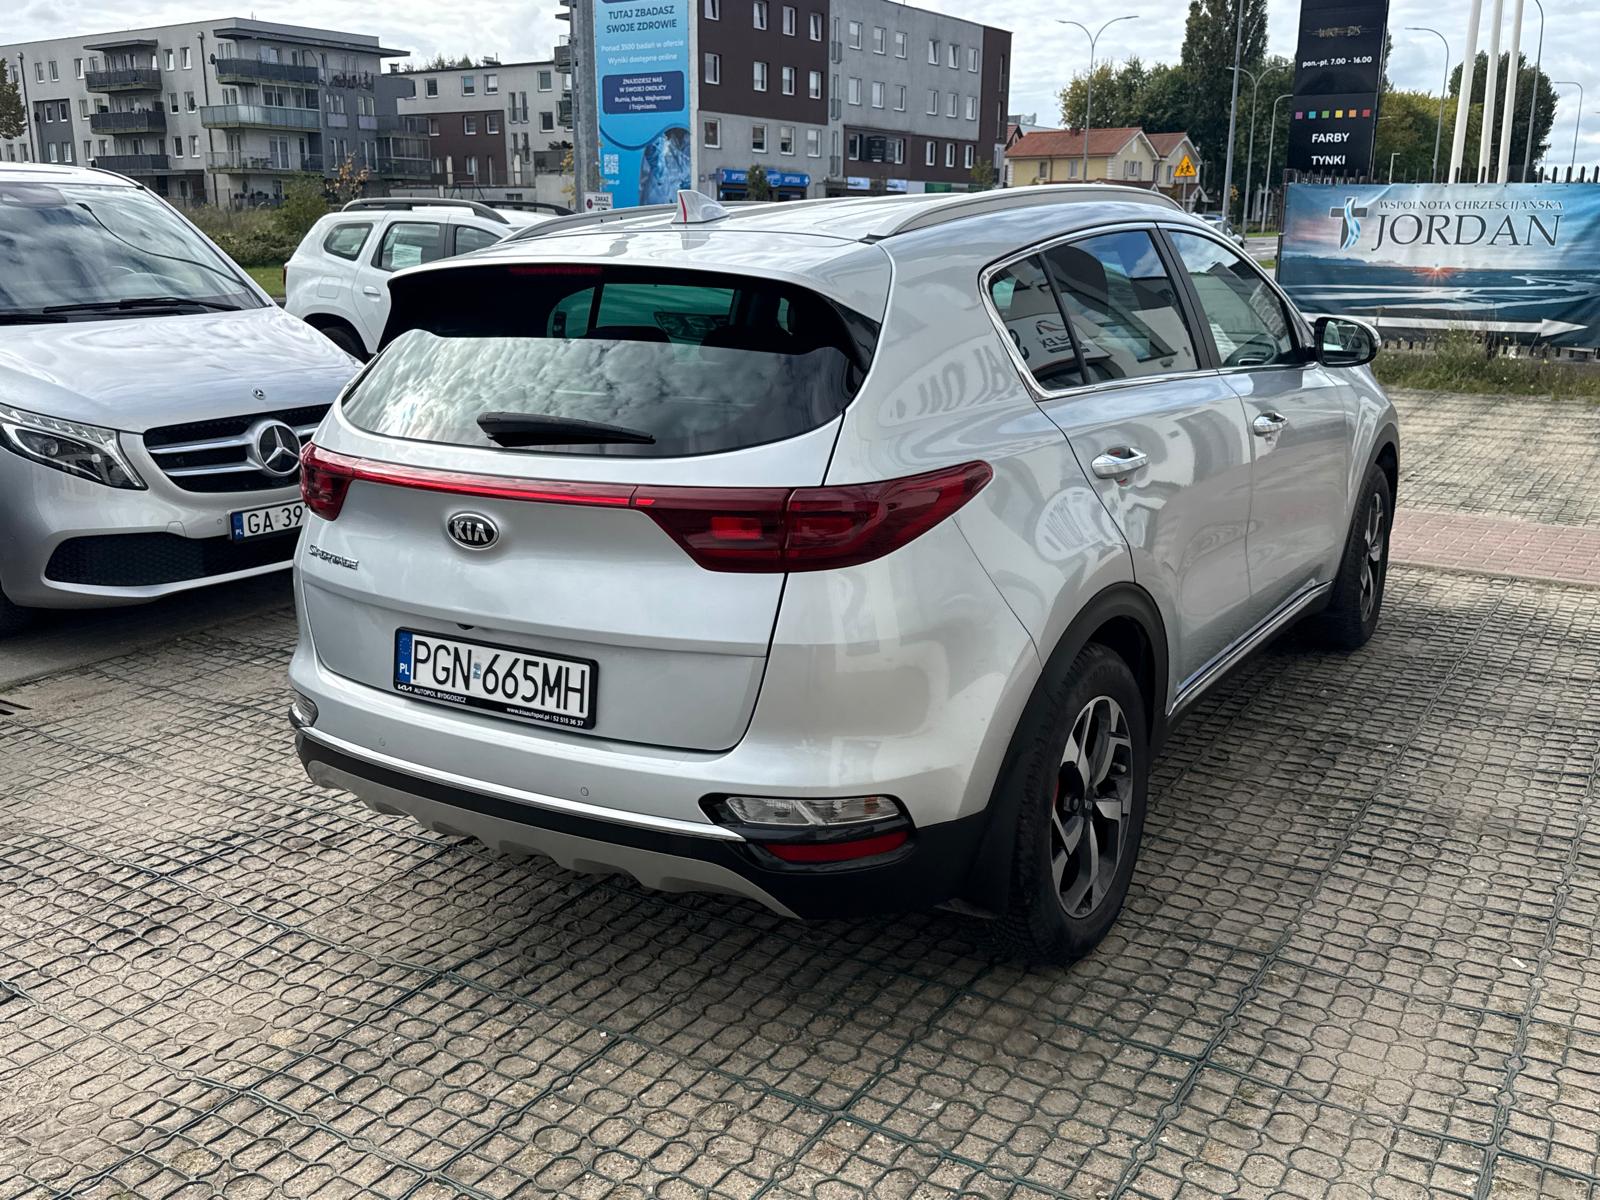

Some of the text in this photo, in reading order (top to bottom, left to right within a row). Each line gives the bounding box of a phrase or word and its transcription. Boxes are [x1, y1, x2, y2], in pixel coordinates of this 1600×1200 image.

[608, 5, 674, 19] TUTAJ ZBADASZ
[606, 19, 677, 33] SWOJE ZDROWIE
[1312, 133, 1349, 143] FARBY
[1311, 155, 1345, 165] TYNKI
[1371, 214, 1564, 251] JORDAN
[248, 511, 273, 534] GA
[281, 506, 307, 528] 39
[454, 520, 489, 542] KIA
[400, 640, 585, 713] PL PGN 665MH
[414, 688, 436, 697] AUTOPOL
